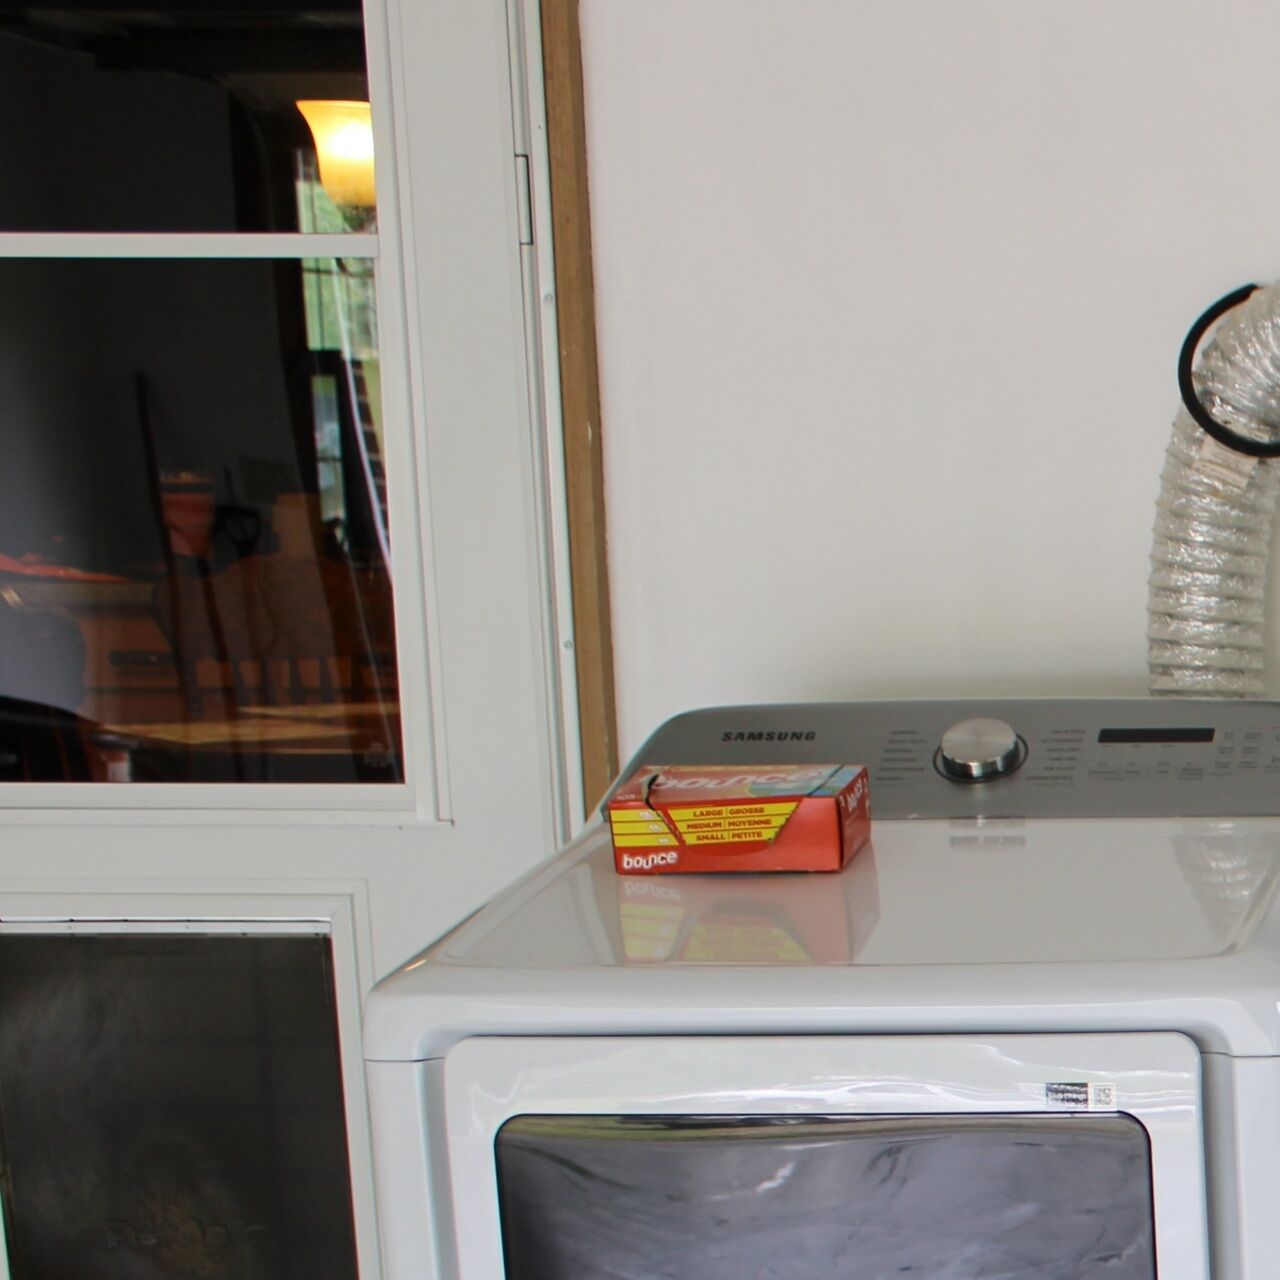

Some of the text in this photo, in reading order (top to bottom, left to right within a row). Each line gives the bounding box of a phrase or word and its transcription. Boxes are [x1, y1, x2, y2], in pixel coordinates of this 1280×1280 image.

[721, 731, 816, 742] SAMSUNG
[693, 806, 765, 818] LARGE GROSSE
[686, 818, 772, 829] MEDIUM MOYENNE
[696, 831, 762, 841] SMALL PETITE
[623, 851, 678, 869] bounce
